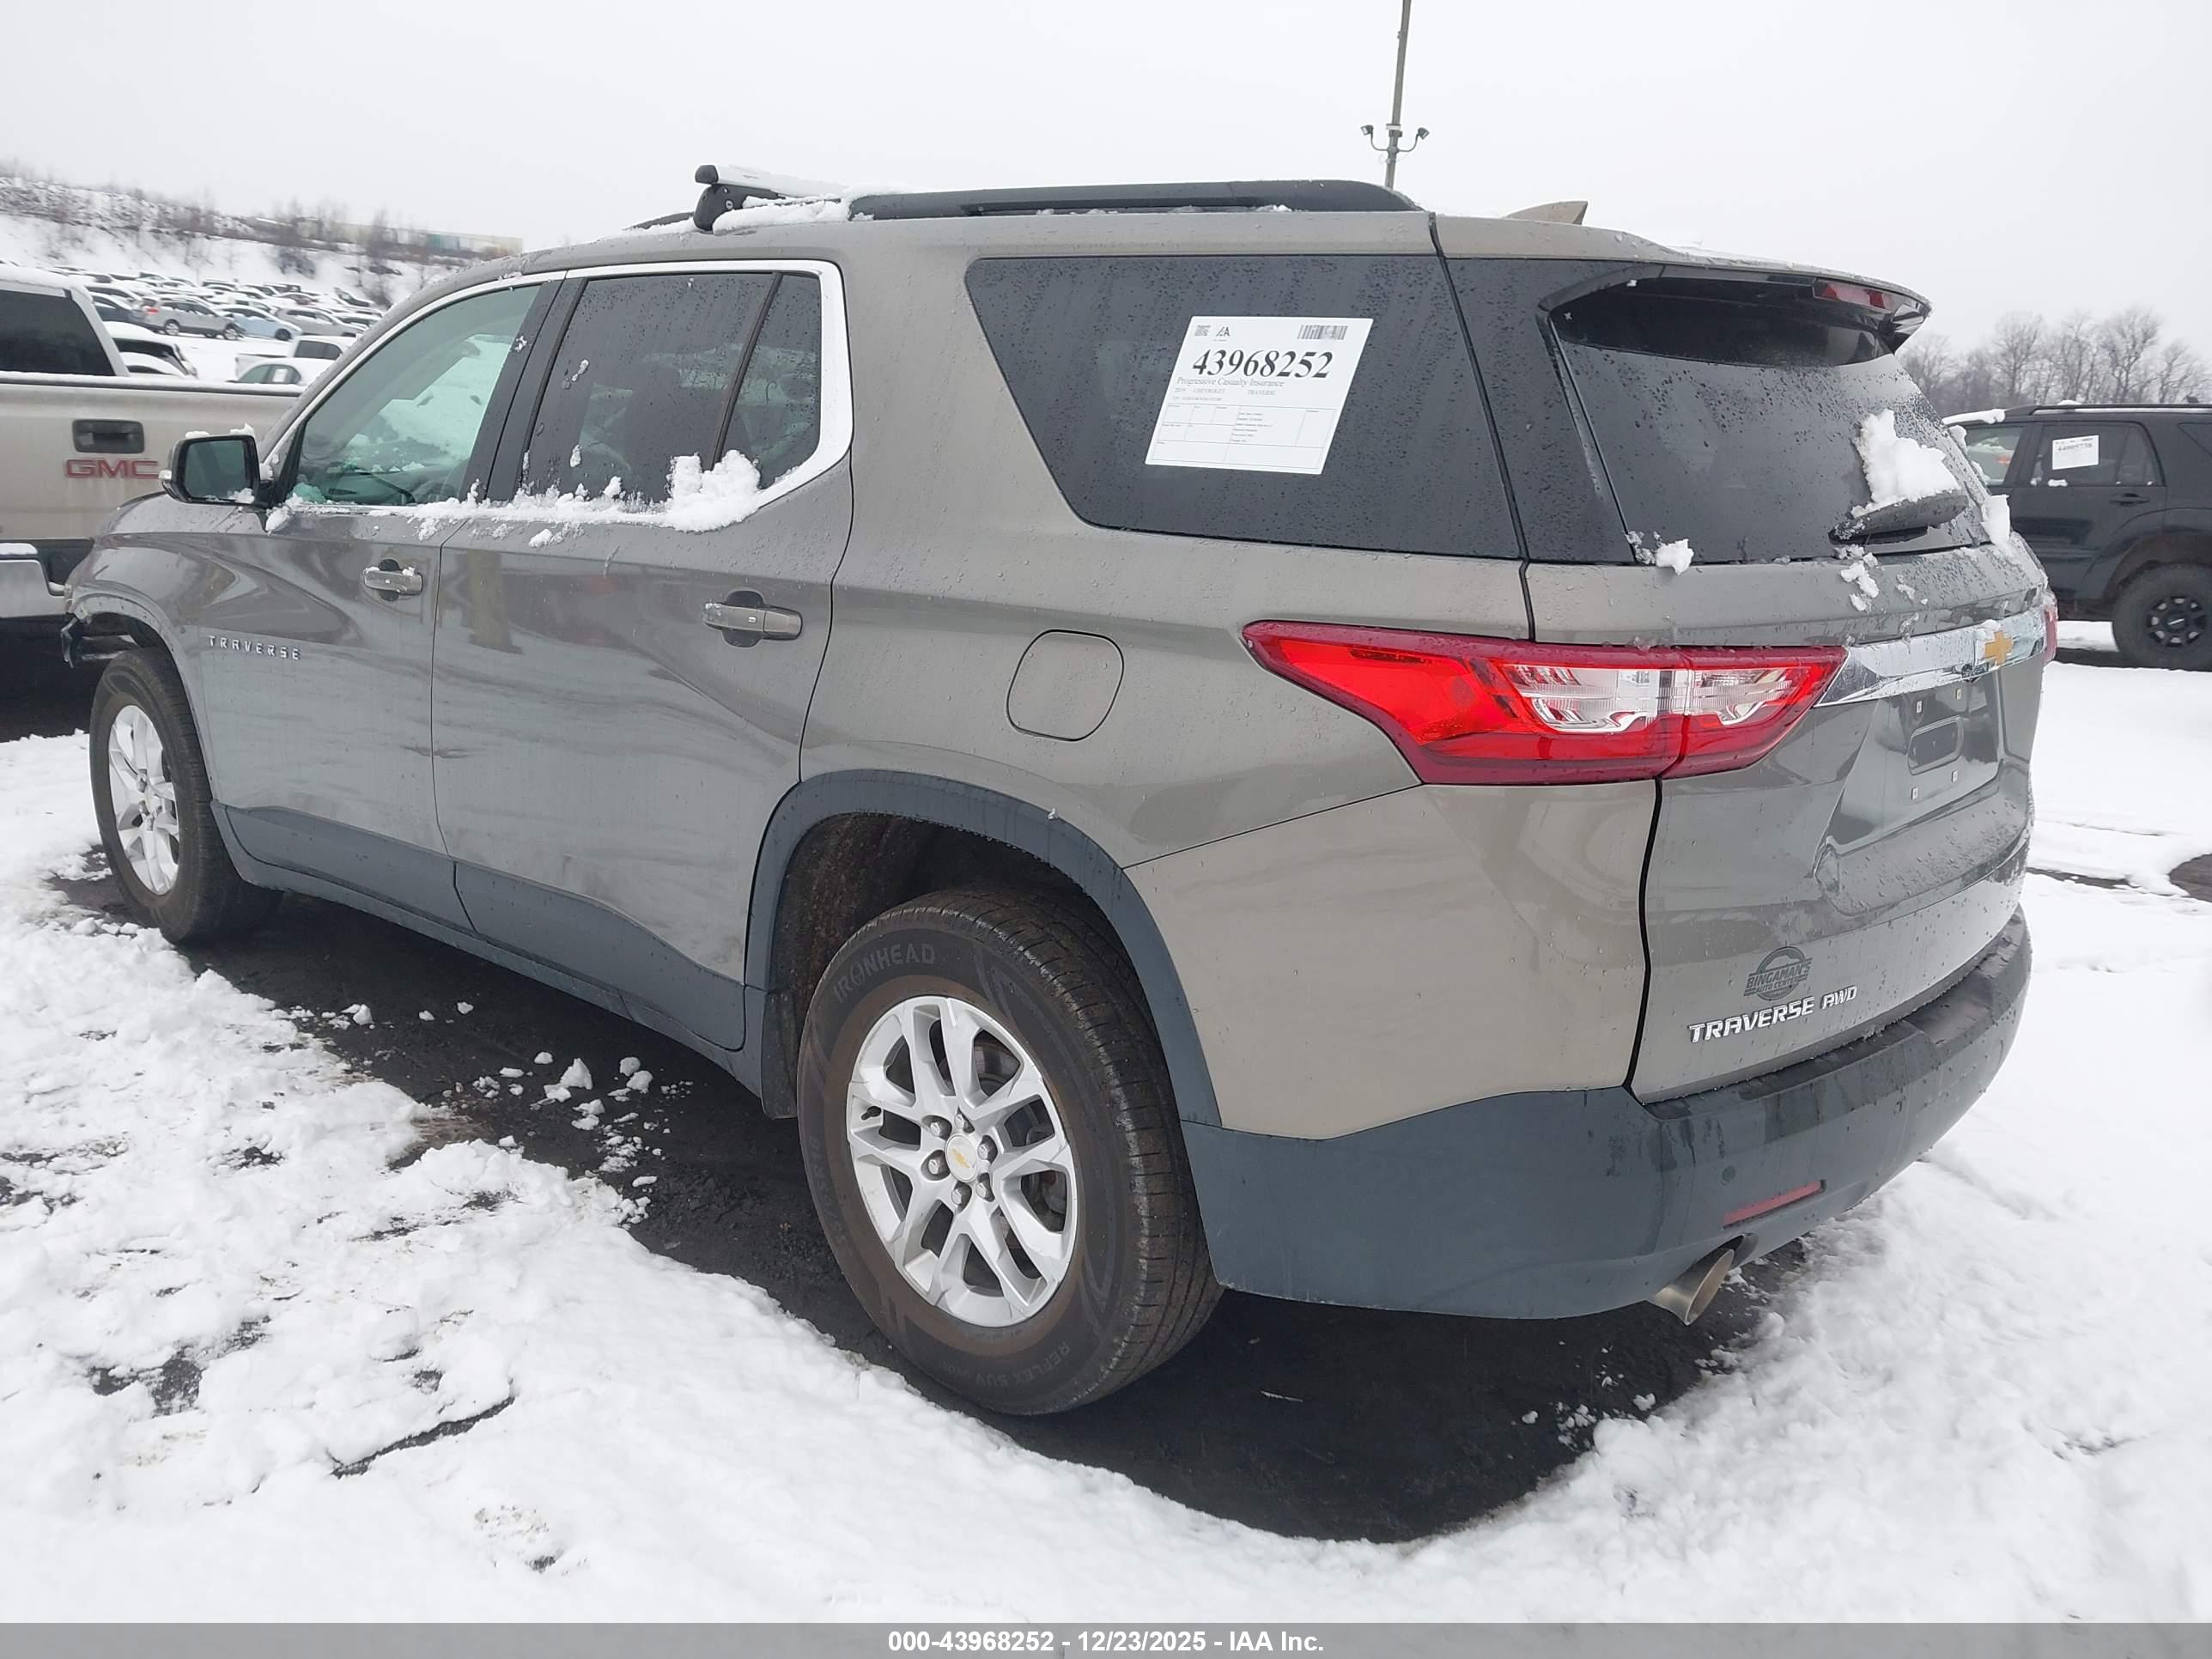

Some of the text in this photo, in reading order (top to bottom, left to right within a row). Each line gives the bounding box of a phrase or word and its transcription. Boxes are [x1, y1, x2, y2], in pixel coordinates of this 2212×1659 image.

[1192, 349, 1334, 379] 43968252
[1176, 376, 1216, 386] Progressive
[1249, 379, 1285, 387] Insurance
[64, 458, 158, 480] GMC
[209, 635, 301, 660] TRAVERSE
[833, 943, 936, 1003] IRONHEAD
[1746, 961, 1812, 988] BINGAMAN'S
[1688, 985, 1858, 1042] TRAVERSE AWD
